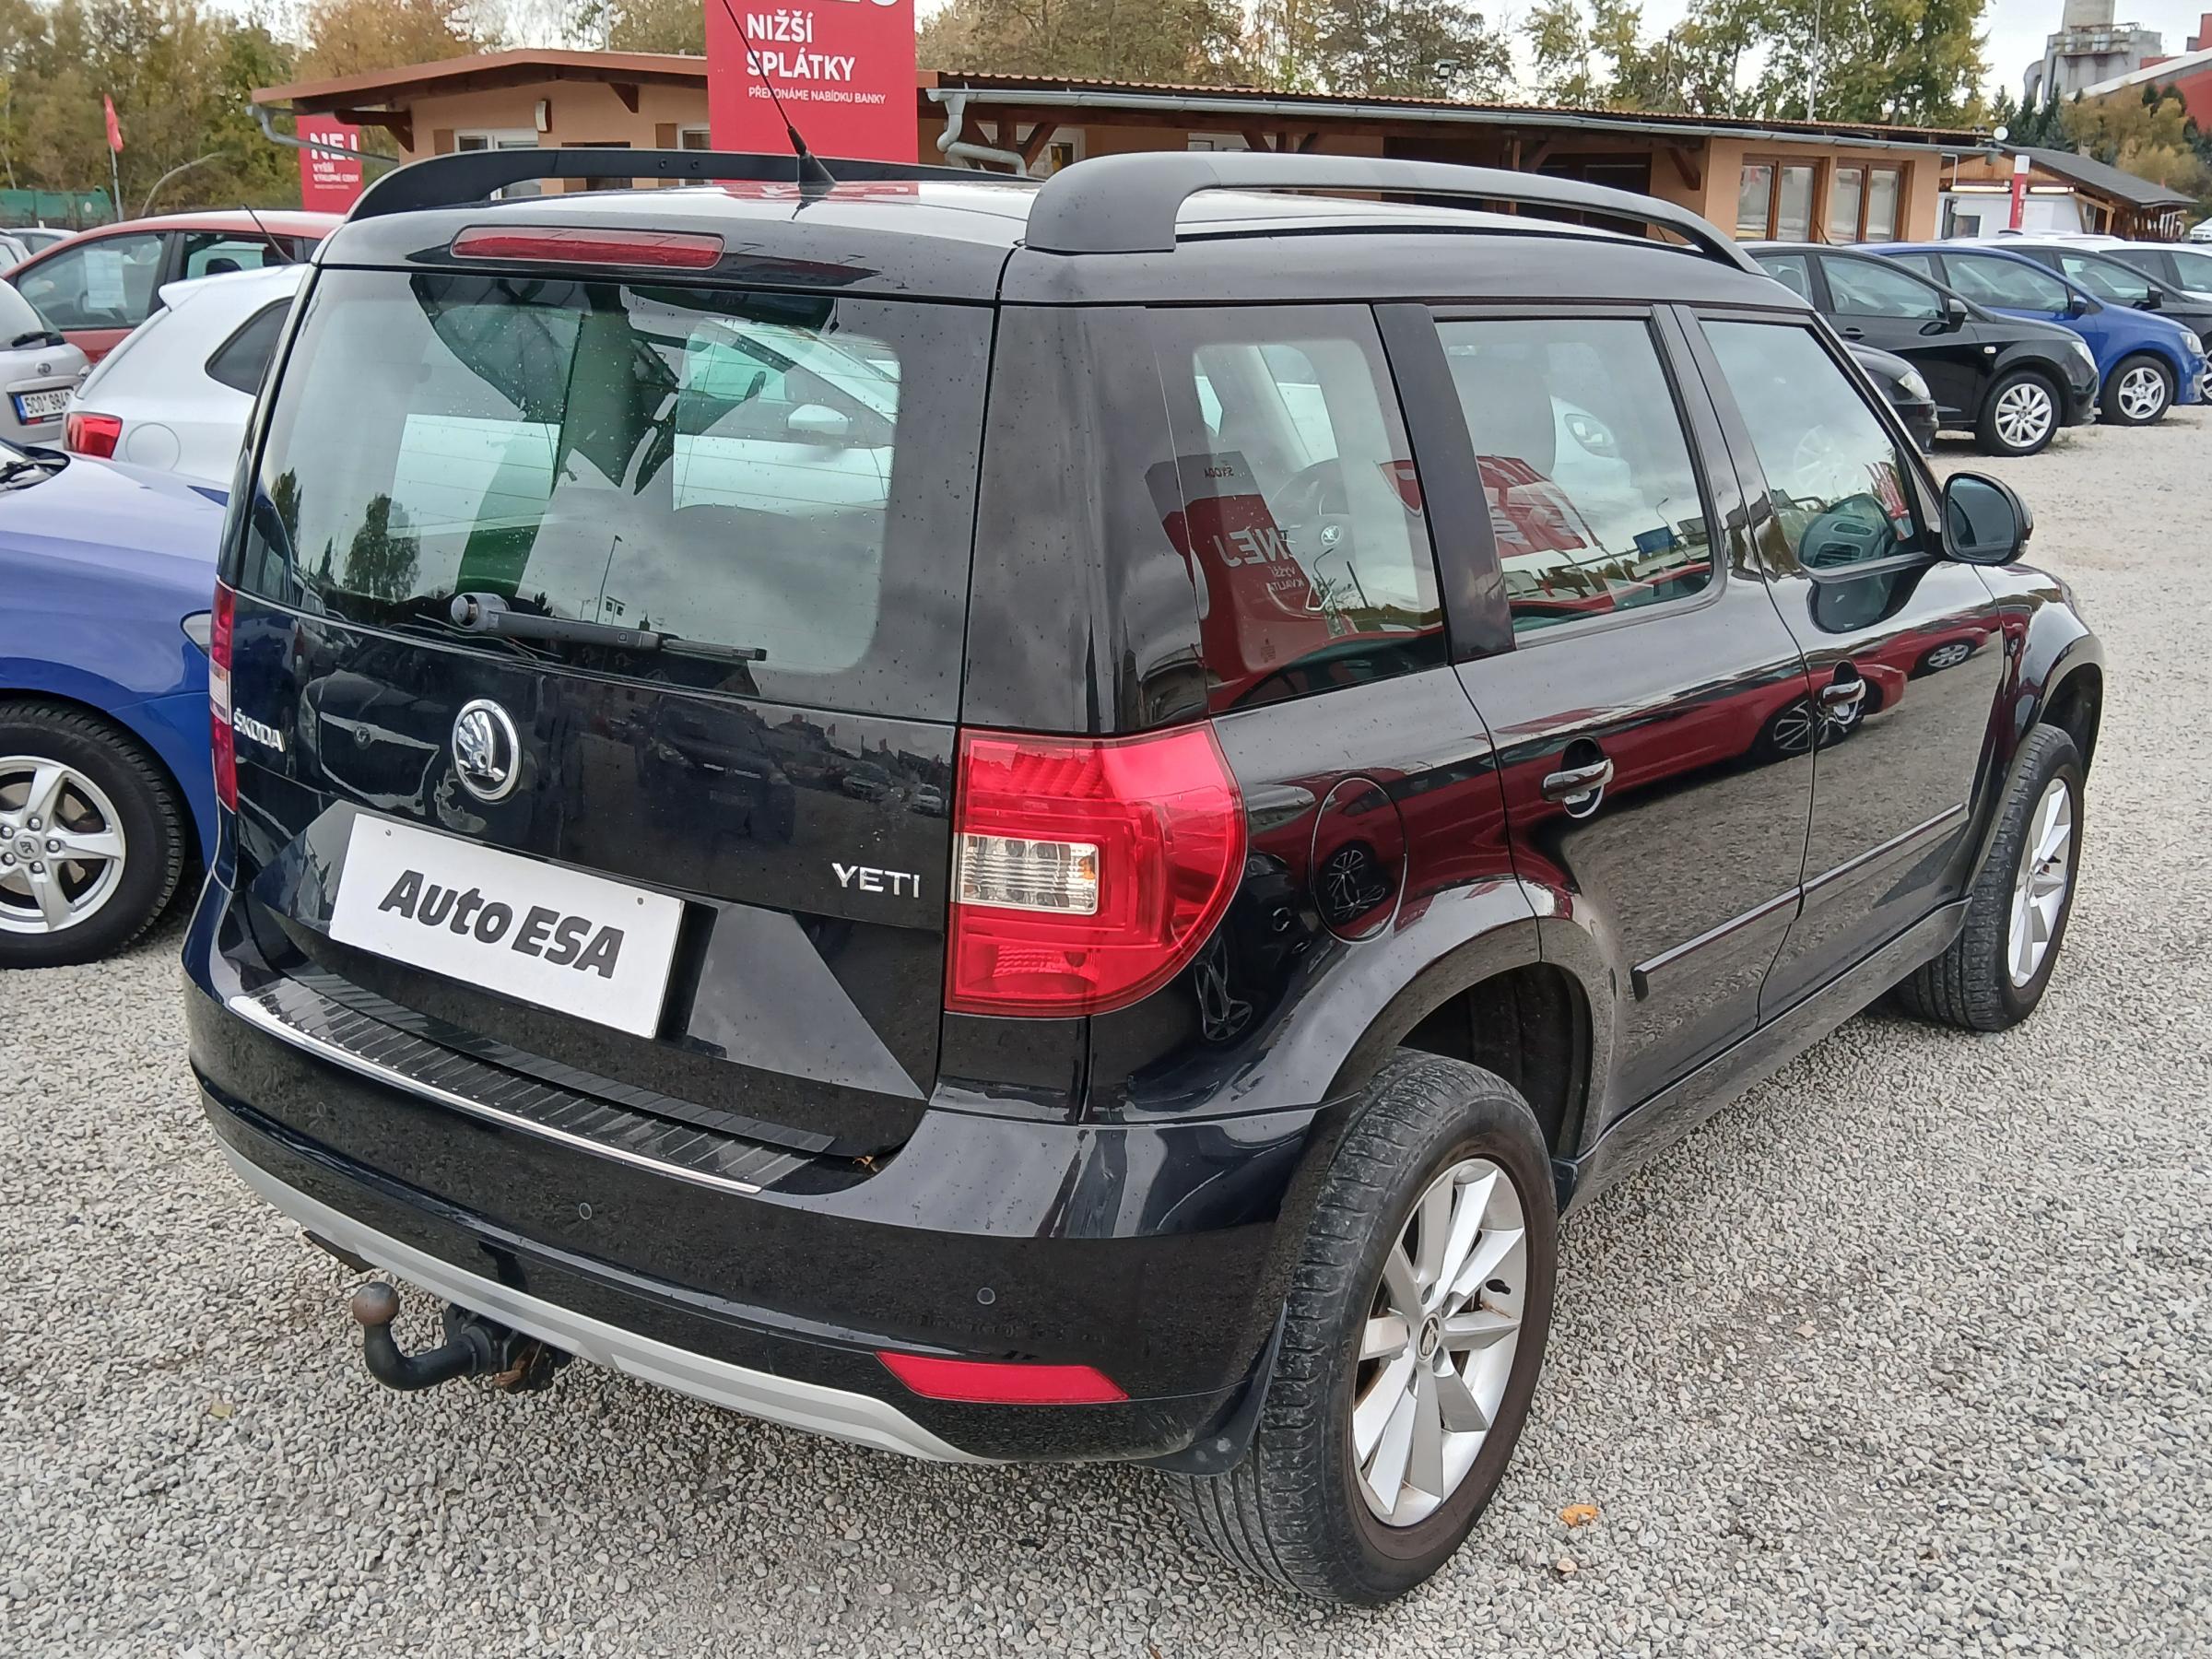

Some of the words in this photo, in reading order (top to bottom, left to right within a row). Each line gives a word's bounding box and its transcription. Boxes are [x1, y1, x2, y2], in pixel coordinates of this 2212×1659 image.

[747, 9, 814, 43] NIŽŠÍ
[746, 47, 855, 81] SPLÁTKY
[811, 89, 853, 103] NABÍDKU
[854, 92, 886, 104] BANKY
[233, 707, 287, 752] ŠKODA
[831, 862, 920, 898] YETI
[378, 869, 512, 944] Auto
[511, 905, 624, 979] ESA
